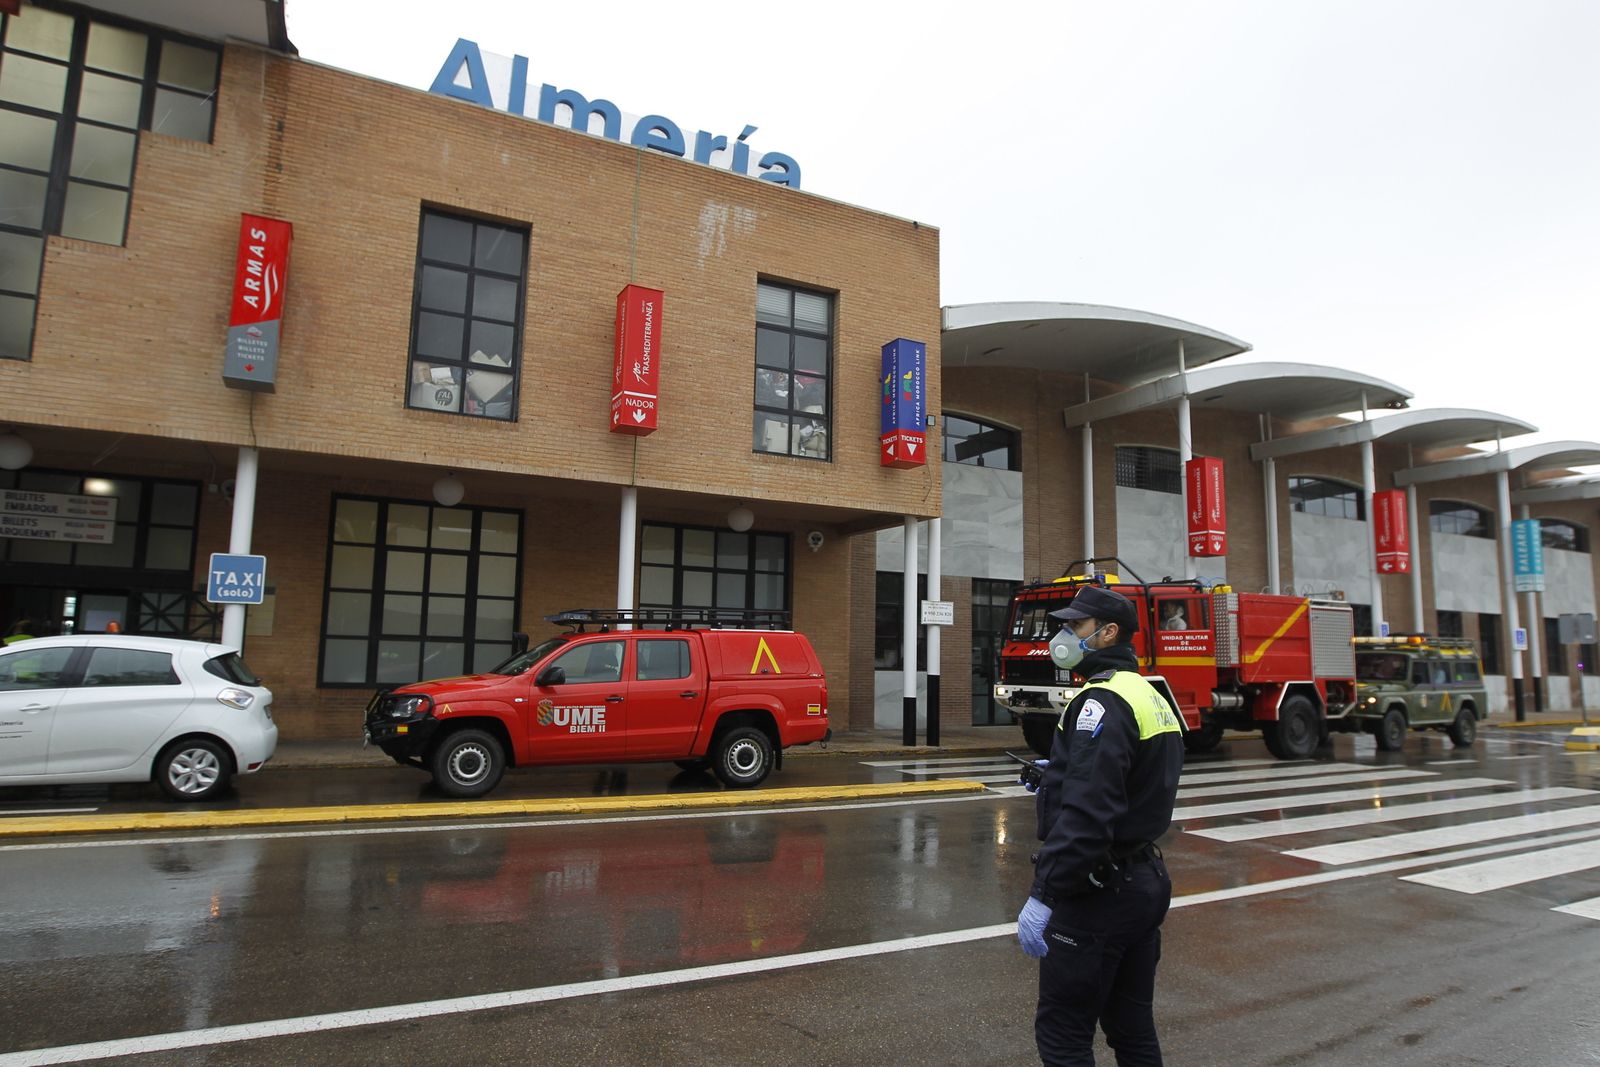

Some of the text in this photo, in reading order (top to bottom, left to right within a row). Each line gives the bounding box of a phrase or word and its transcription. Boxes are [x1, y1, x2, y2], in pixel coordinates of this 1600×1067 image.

[429, 38, 801, 190] Almería
[243, 228, 267, 308] ARMAS
[642, 302, 653, 375] TRASMEDITERRANEA
[625, 398, 655, 409] NADOR
[901, 435, 923, 444] TICKETS
[4, 491, 46, 502] BILLETES
[4, 502, 58, 513] EMBARQUE
[2, 517, 38, 527] BILLETS
[213, 571, 262, 587] TAXI
[217, 587, 254, 598] (solo)
[553, 708, 606, 726] UME
[569, 725, 595, 733] BIEM
